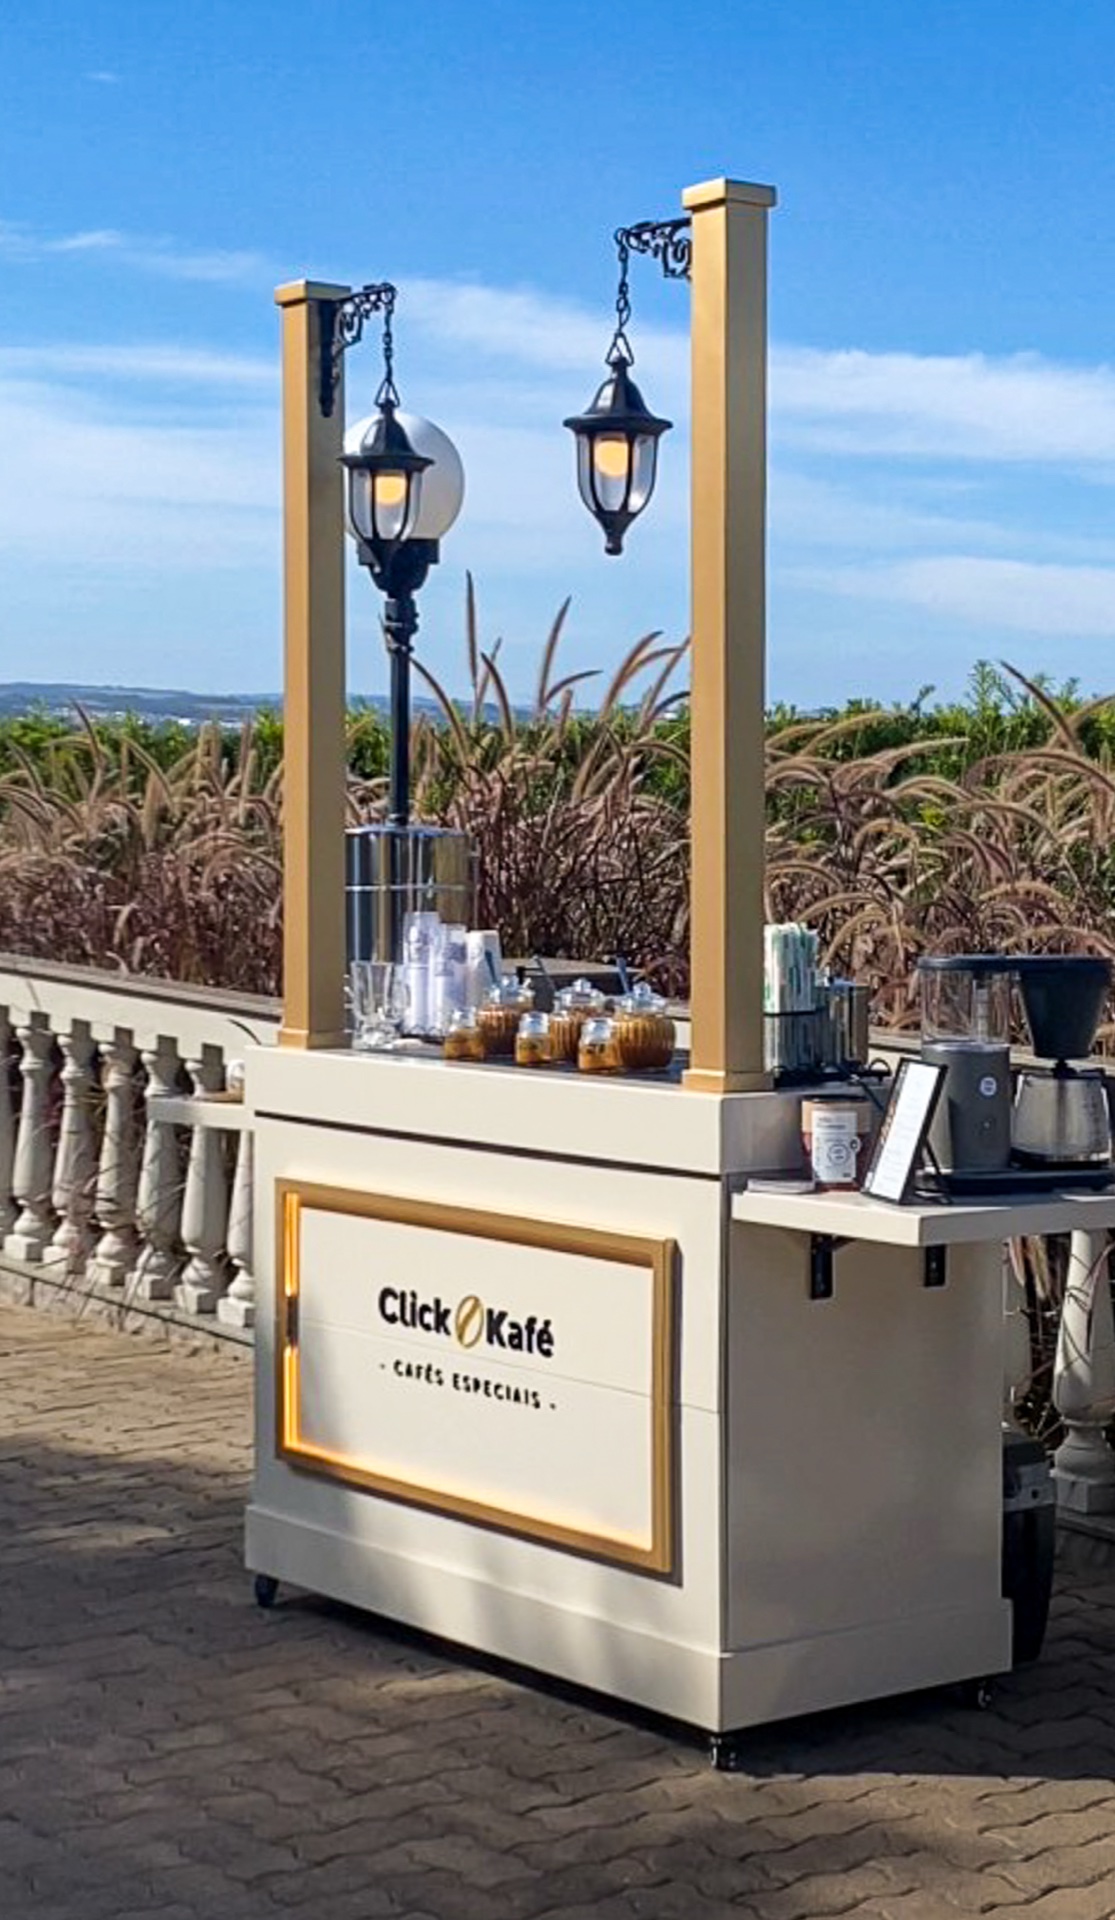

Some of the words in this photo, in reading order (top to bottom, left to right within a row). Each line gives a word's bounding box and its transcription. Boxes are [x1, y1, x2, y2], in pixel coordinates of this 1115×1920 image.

[378, 1286, 451, 1336] Click
[486, 1307, 554, 1358] Kafé
[393, 1359, 444, 1386] CAFÉS
[452, 1373, 541, 1409] ESPECIAIS
